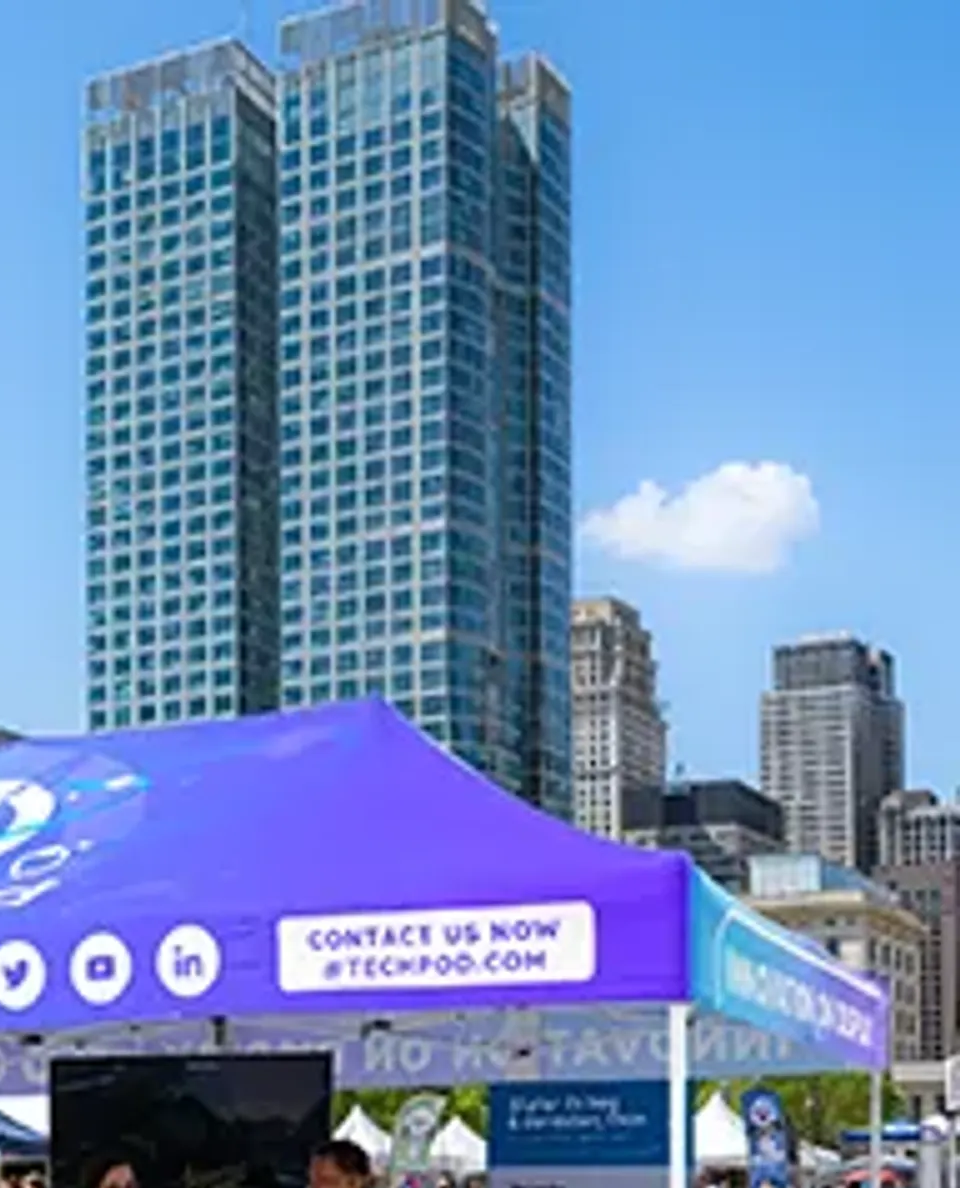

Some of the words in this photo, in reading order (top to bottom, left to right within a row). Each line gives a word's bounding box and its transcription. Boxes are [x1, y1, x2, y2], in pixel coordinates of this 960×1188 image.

[306, 925, 432, 951] CONTACT
[444, 922, 481, 946] US
[489, 918, 562, 942] NOW
